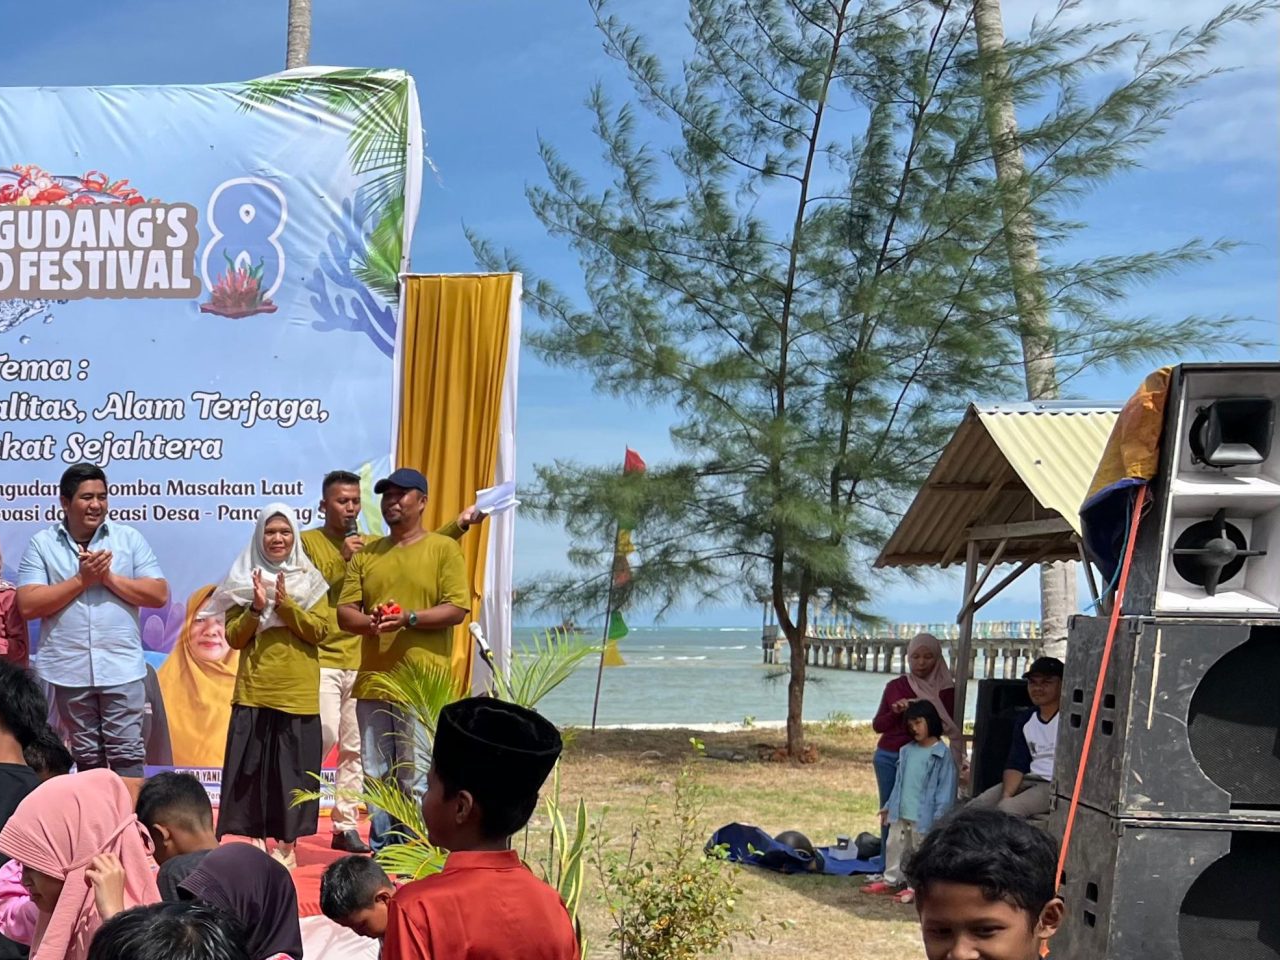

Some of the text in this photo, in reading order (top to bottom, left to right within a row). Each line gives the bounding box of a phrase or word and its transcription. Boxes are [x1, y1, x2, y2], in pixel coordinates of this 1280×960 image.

[18, 250, 191, 292] FESTIVAL
[93, 391, 185, 421] Alam
[191, 391, 329, 429] Terjaga,
[62, 431, 223, 468] Sejahtera
[108, 479, 161, 496] omba
[166, 479, 255, 496] Masakan
[261, 480, 303, 496] Laut
[152, 505, 200, 521] Desa
